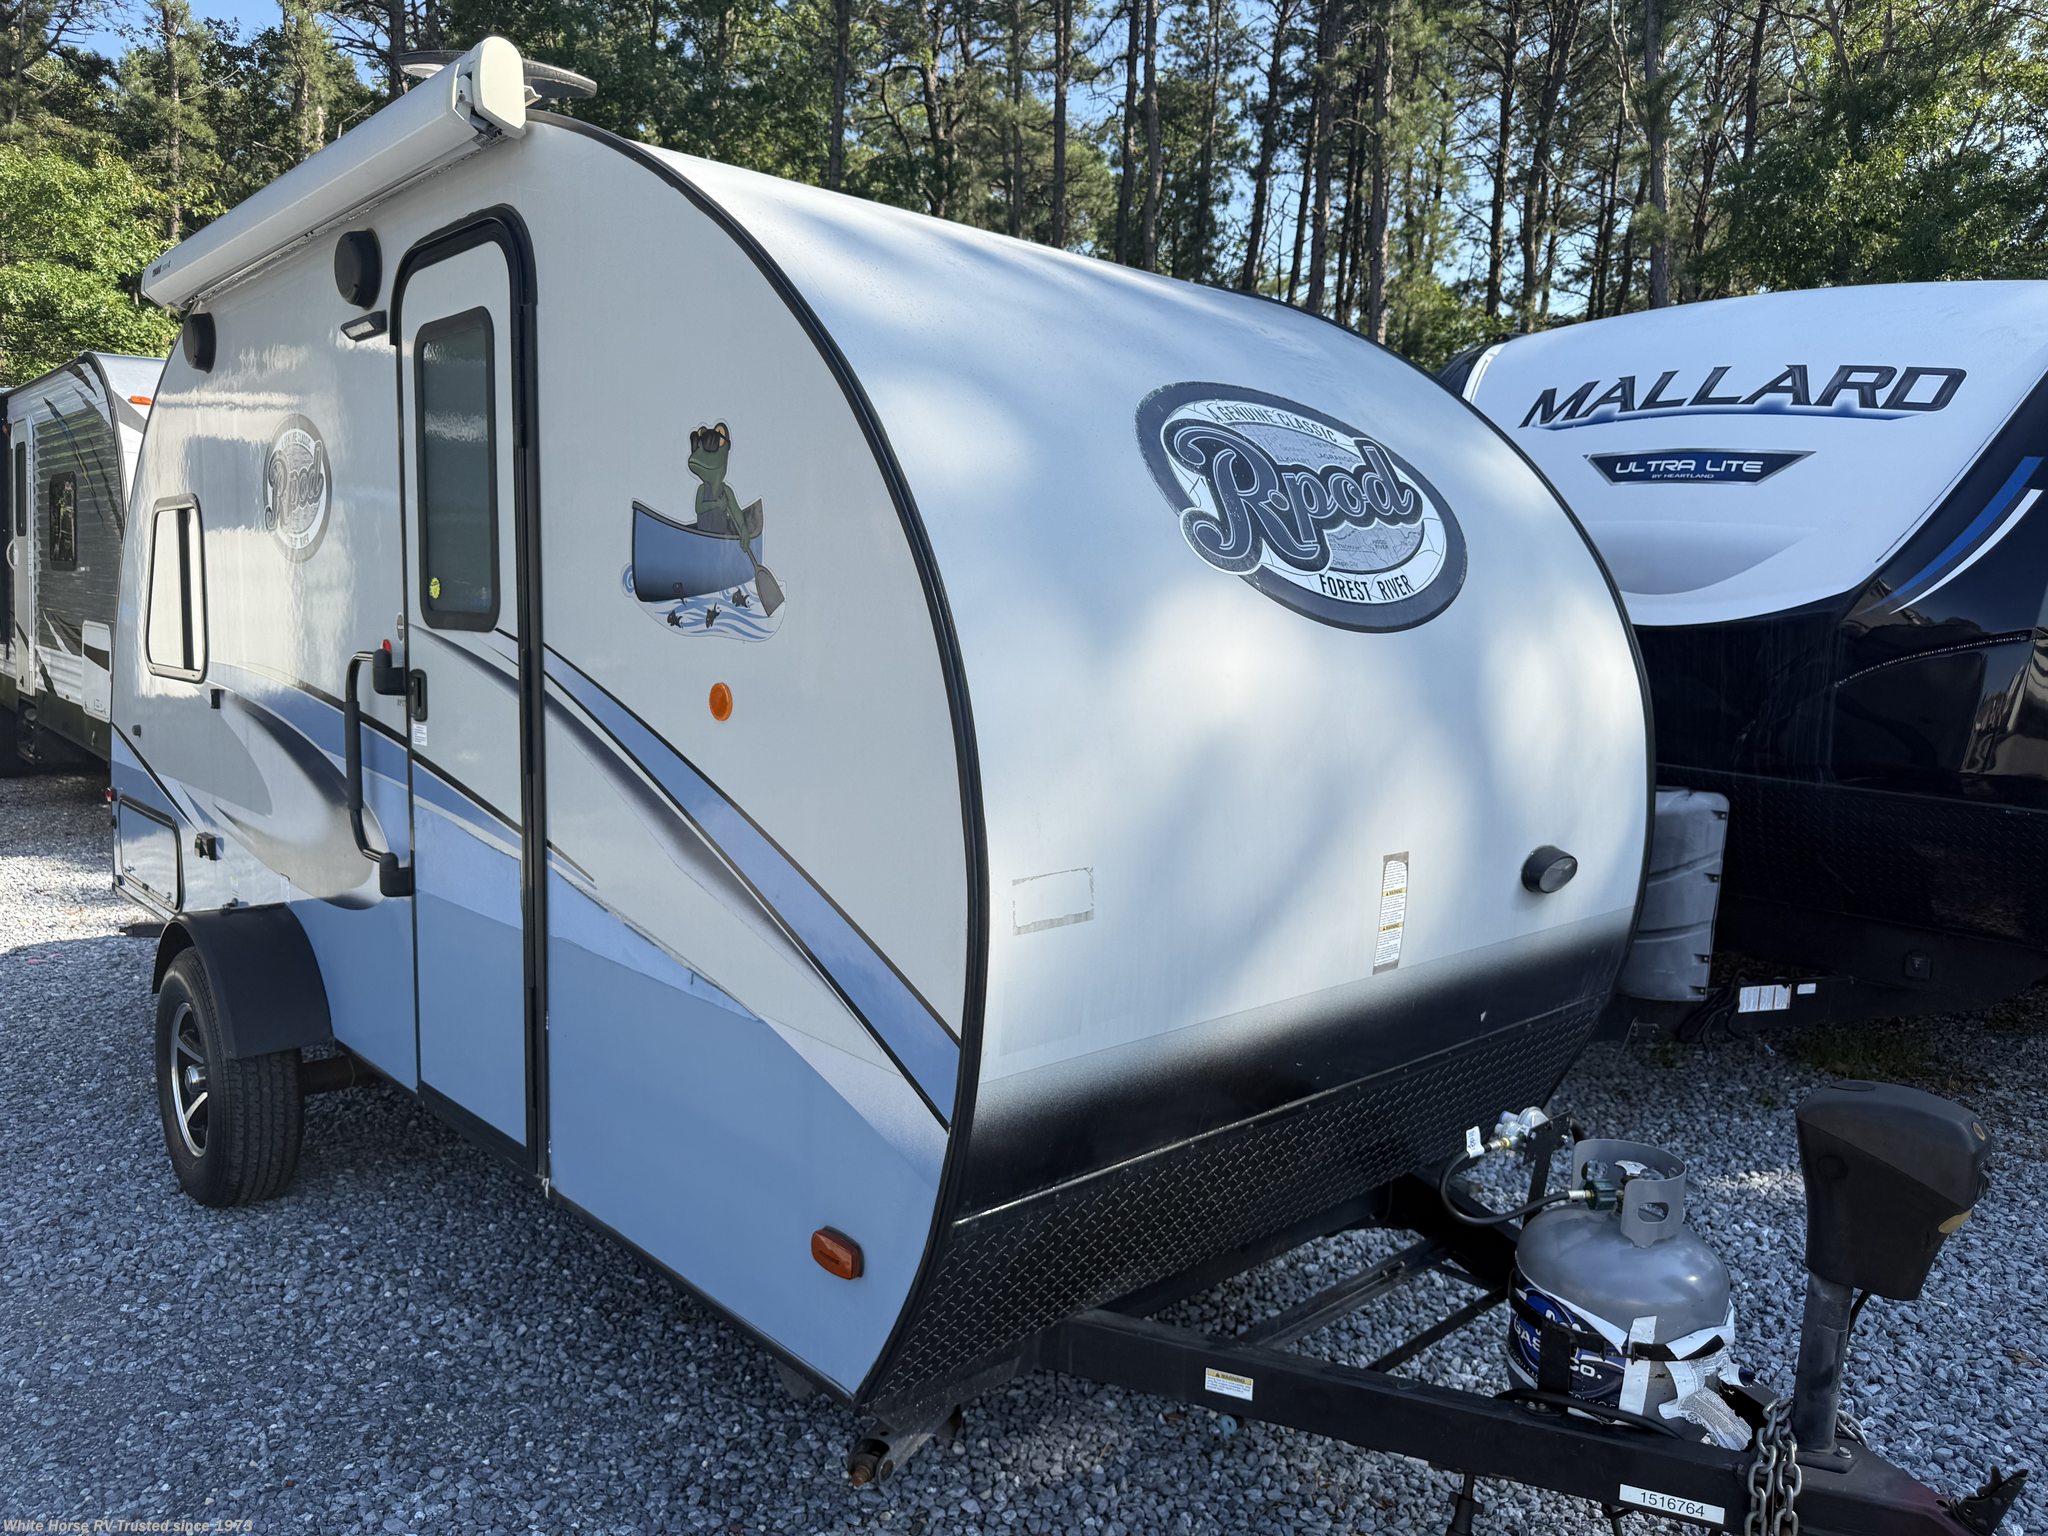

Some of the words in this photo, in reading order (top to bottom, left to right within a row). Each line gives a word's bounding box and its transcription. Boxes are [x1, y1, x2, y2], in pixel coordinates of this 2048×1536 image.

[1518, 364, 1968, 429] MALLARD
[1206, 407, 1224, 423] A
[1217, 406, 1279, 424] GENUINE
[1276, 412, 1338, 444] CLASSIC
[1615, 459, 1697, 474] ULTRA
[1705, 459, 1764, 473] LITE
[1318, 573, 1372, 602] FOREST
[1377, 574, 1415, 601] RIVER
[1640, 1491, 1705, 1517] 1516764
